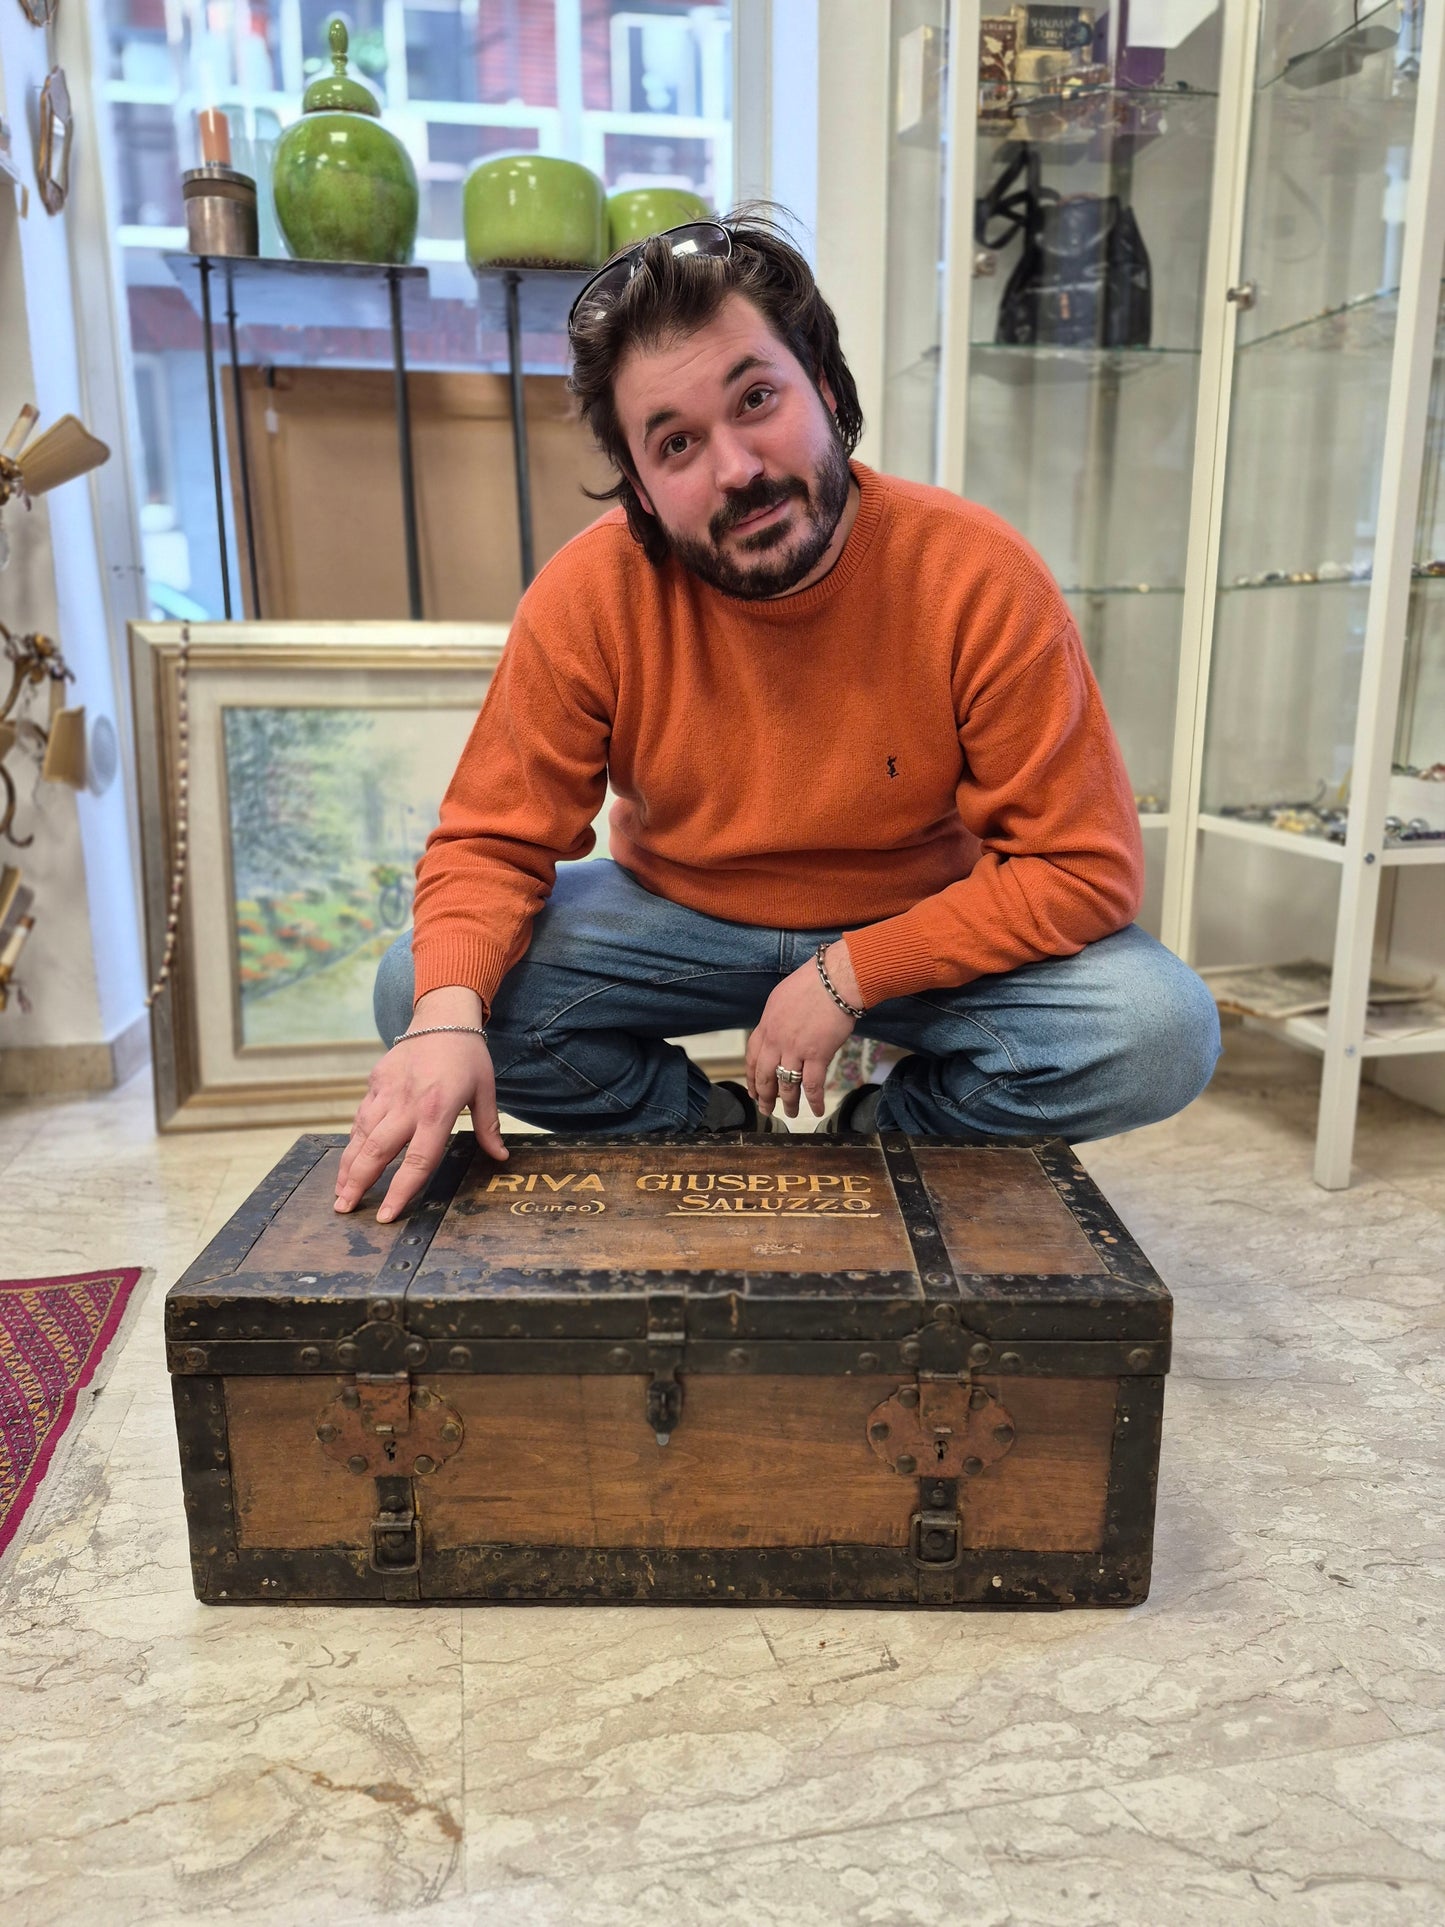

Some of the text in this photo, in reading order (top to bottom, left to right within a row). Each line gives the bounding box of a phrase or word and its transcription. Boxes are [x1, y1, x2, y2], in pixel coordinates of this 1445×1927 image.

[486, 1173, 871, 1193] RIVA GIUSEPPE
[510, 1200, 606, 1216] (Cuneo)
